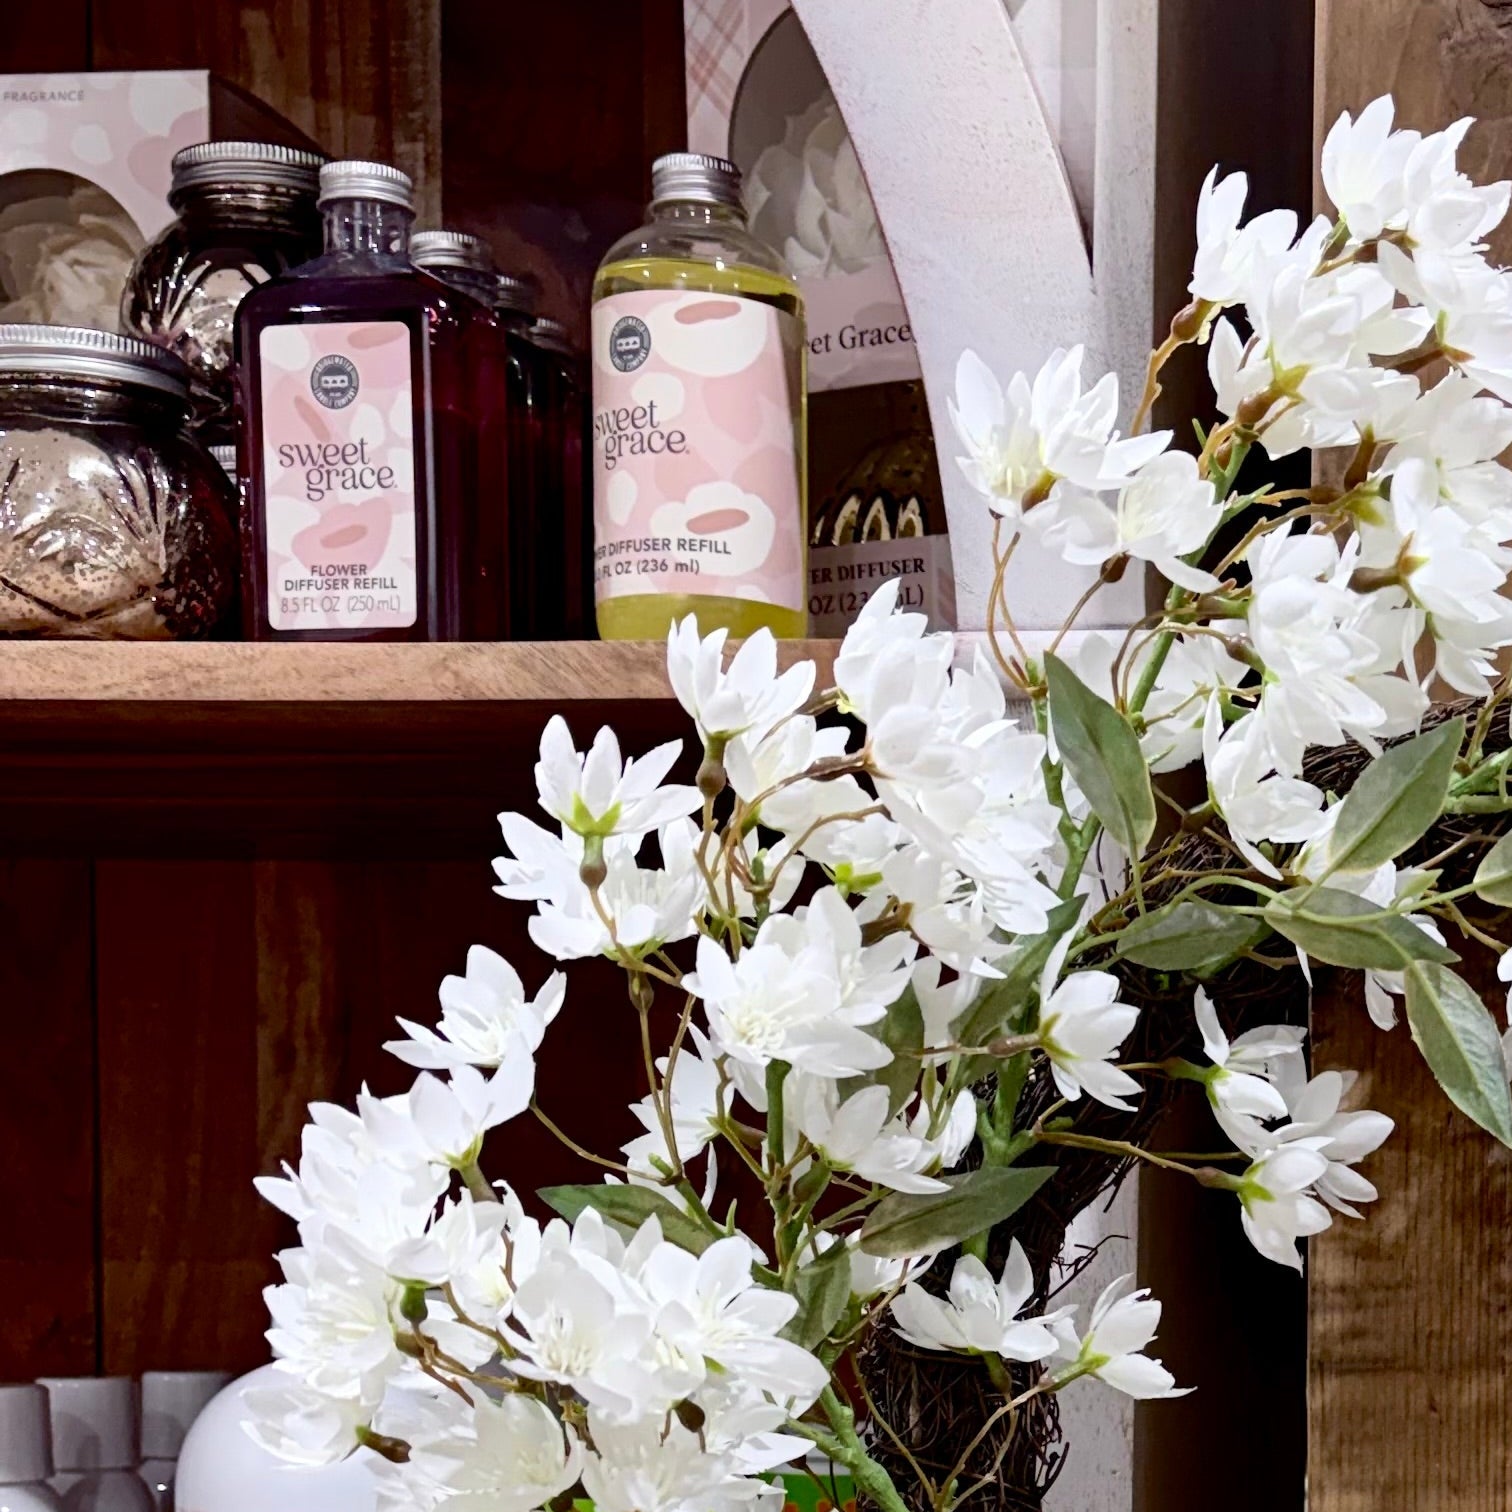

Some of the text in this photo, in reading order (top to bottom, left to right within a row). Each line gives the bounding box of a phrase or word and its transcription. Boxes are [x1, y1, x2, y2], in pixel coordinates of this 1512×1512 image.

[279, 437, 371, 468] sweet
[609, 538, 672, 556] DIFFUSER
[677, 538, 732, 555] REFILL
[311, 564, 368, 577] FLOWER
[615, 561, 632, 575] OZ
[637, 560, 669, 576] (236
[837, 558, 926, 581] DIFFUSER
[284, 577, 398, 592] DIFFUSER REFILL
[280, 598, 300, 614] 8.5
[303, 597, 318, 613] FL
[321, 596, 340, 613] OZ
[347, 595, 375, 614] (250
